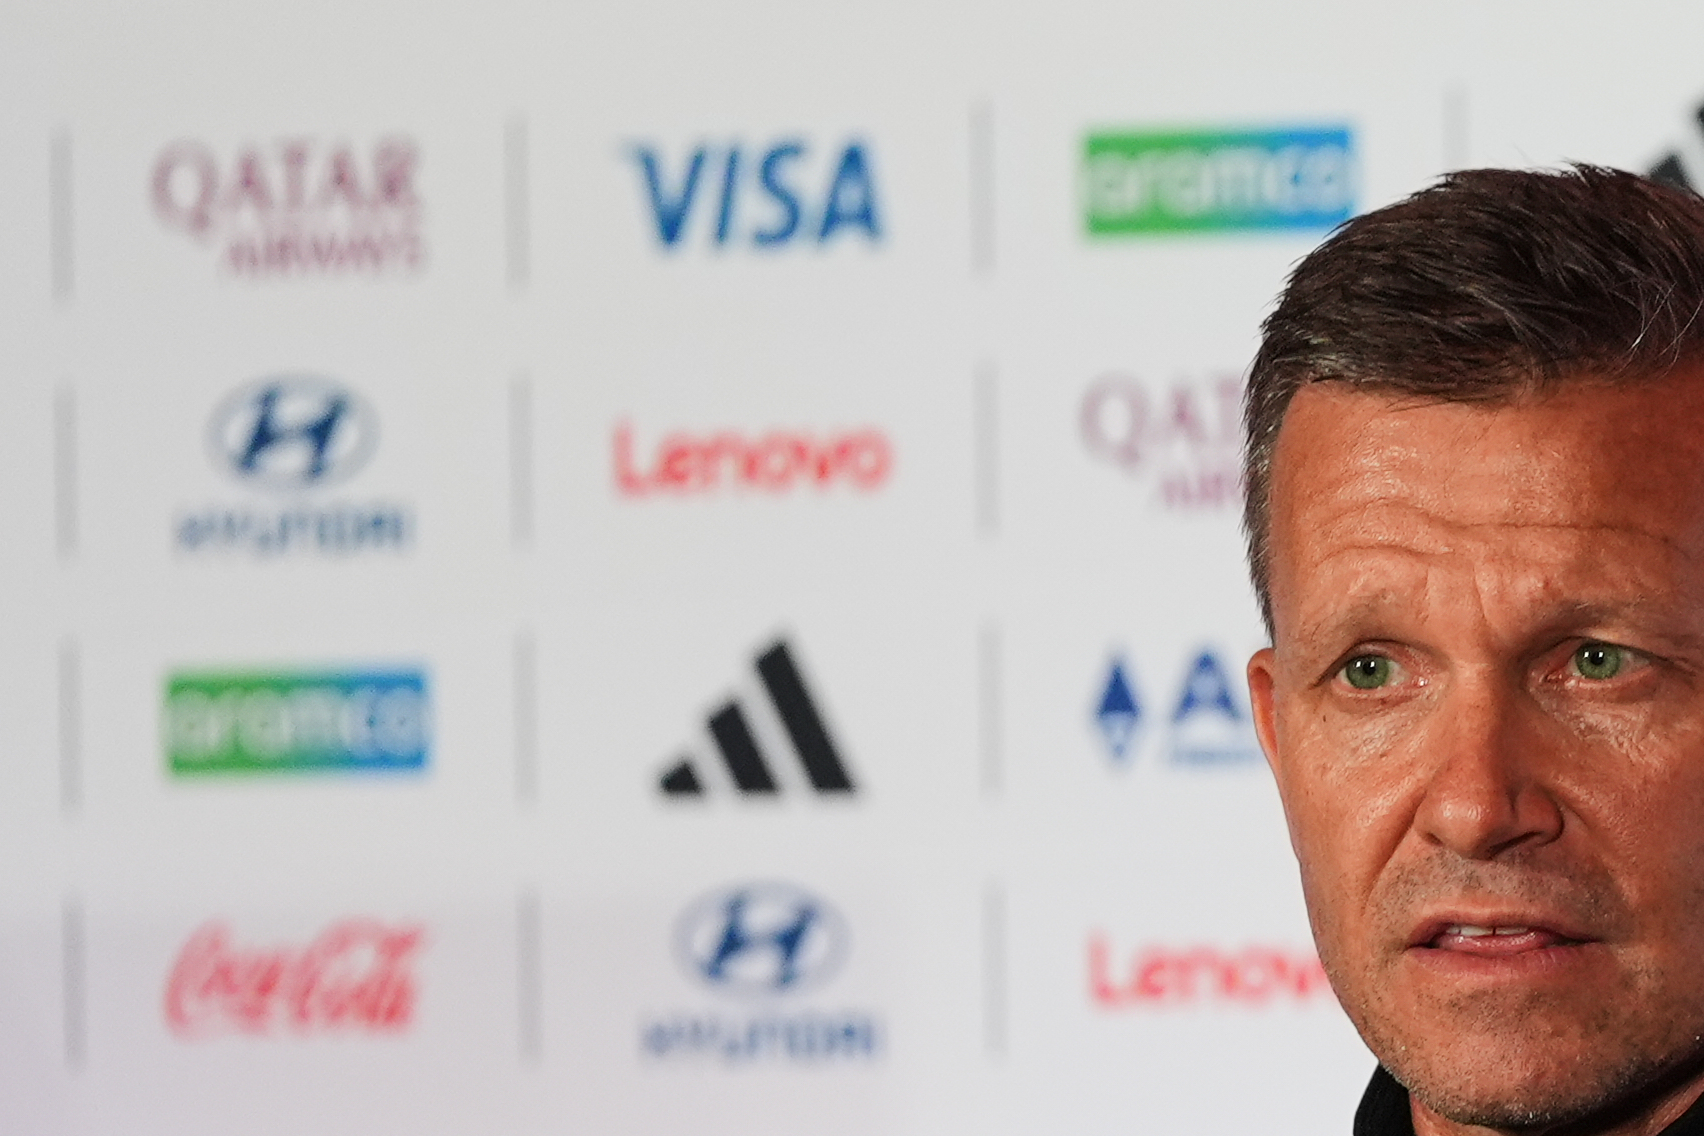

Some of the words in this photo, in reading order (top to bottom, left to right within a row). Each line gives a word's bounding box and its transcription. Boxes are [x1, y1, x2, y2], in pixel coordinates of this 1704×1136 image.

[151, 139, 421, 240] QATAR
[634, 140, 882, 251] VISA
[1083, 136, 1353, 214] aramco
[614, 420, 891, 497] Lenovo
[1089, 928, 1326, 1008] Lenov
